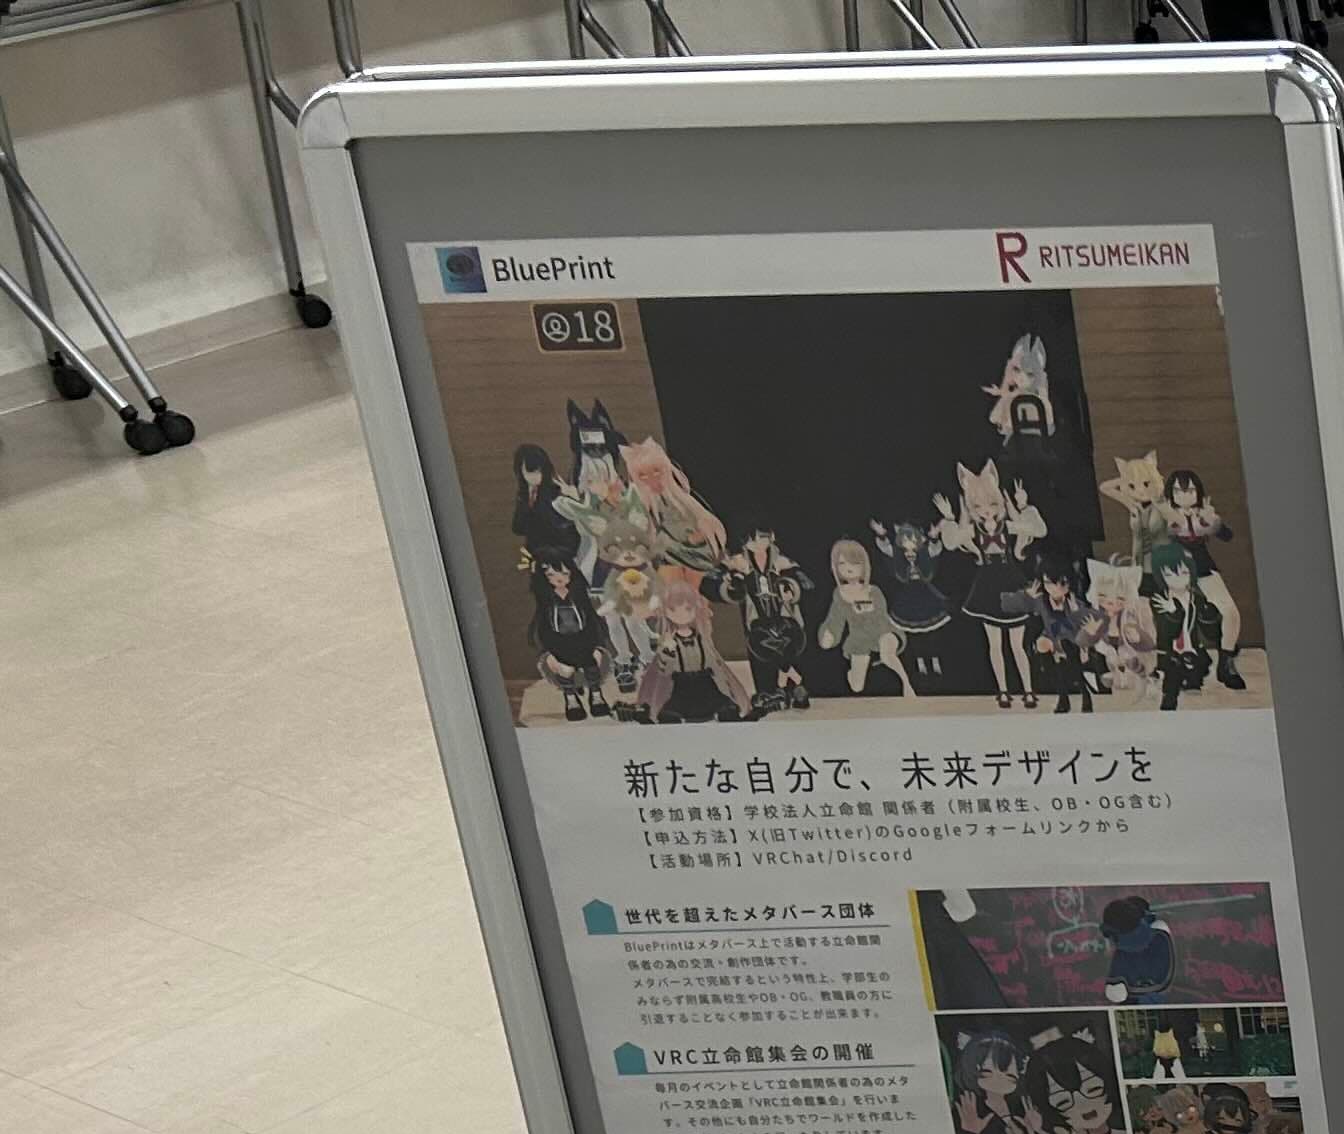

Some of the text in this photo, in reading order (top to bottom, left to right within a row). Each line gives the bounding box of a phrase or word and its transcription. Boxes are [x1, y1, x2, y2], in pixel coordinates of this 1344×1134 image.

[1039, 242, 1190, 268] RITSUMEIKAN
[492, 255, 616, 282] BluePrint
[573, 309, 616, 343] 18
[624, 746, 1152, 798] 新たな自分で、未来デザインを
[625, 902, 876, 926] 世代を超えたメタバース団体
[654, 1043, 875, 1065] VRC立命館集会の開催
